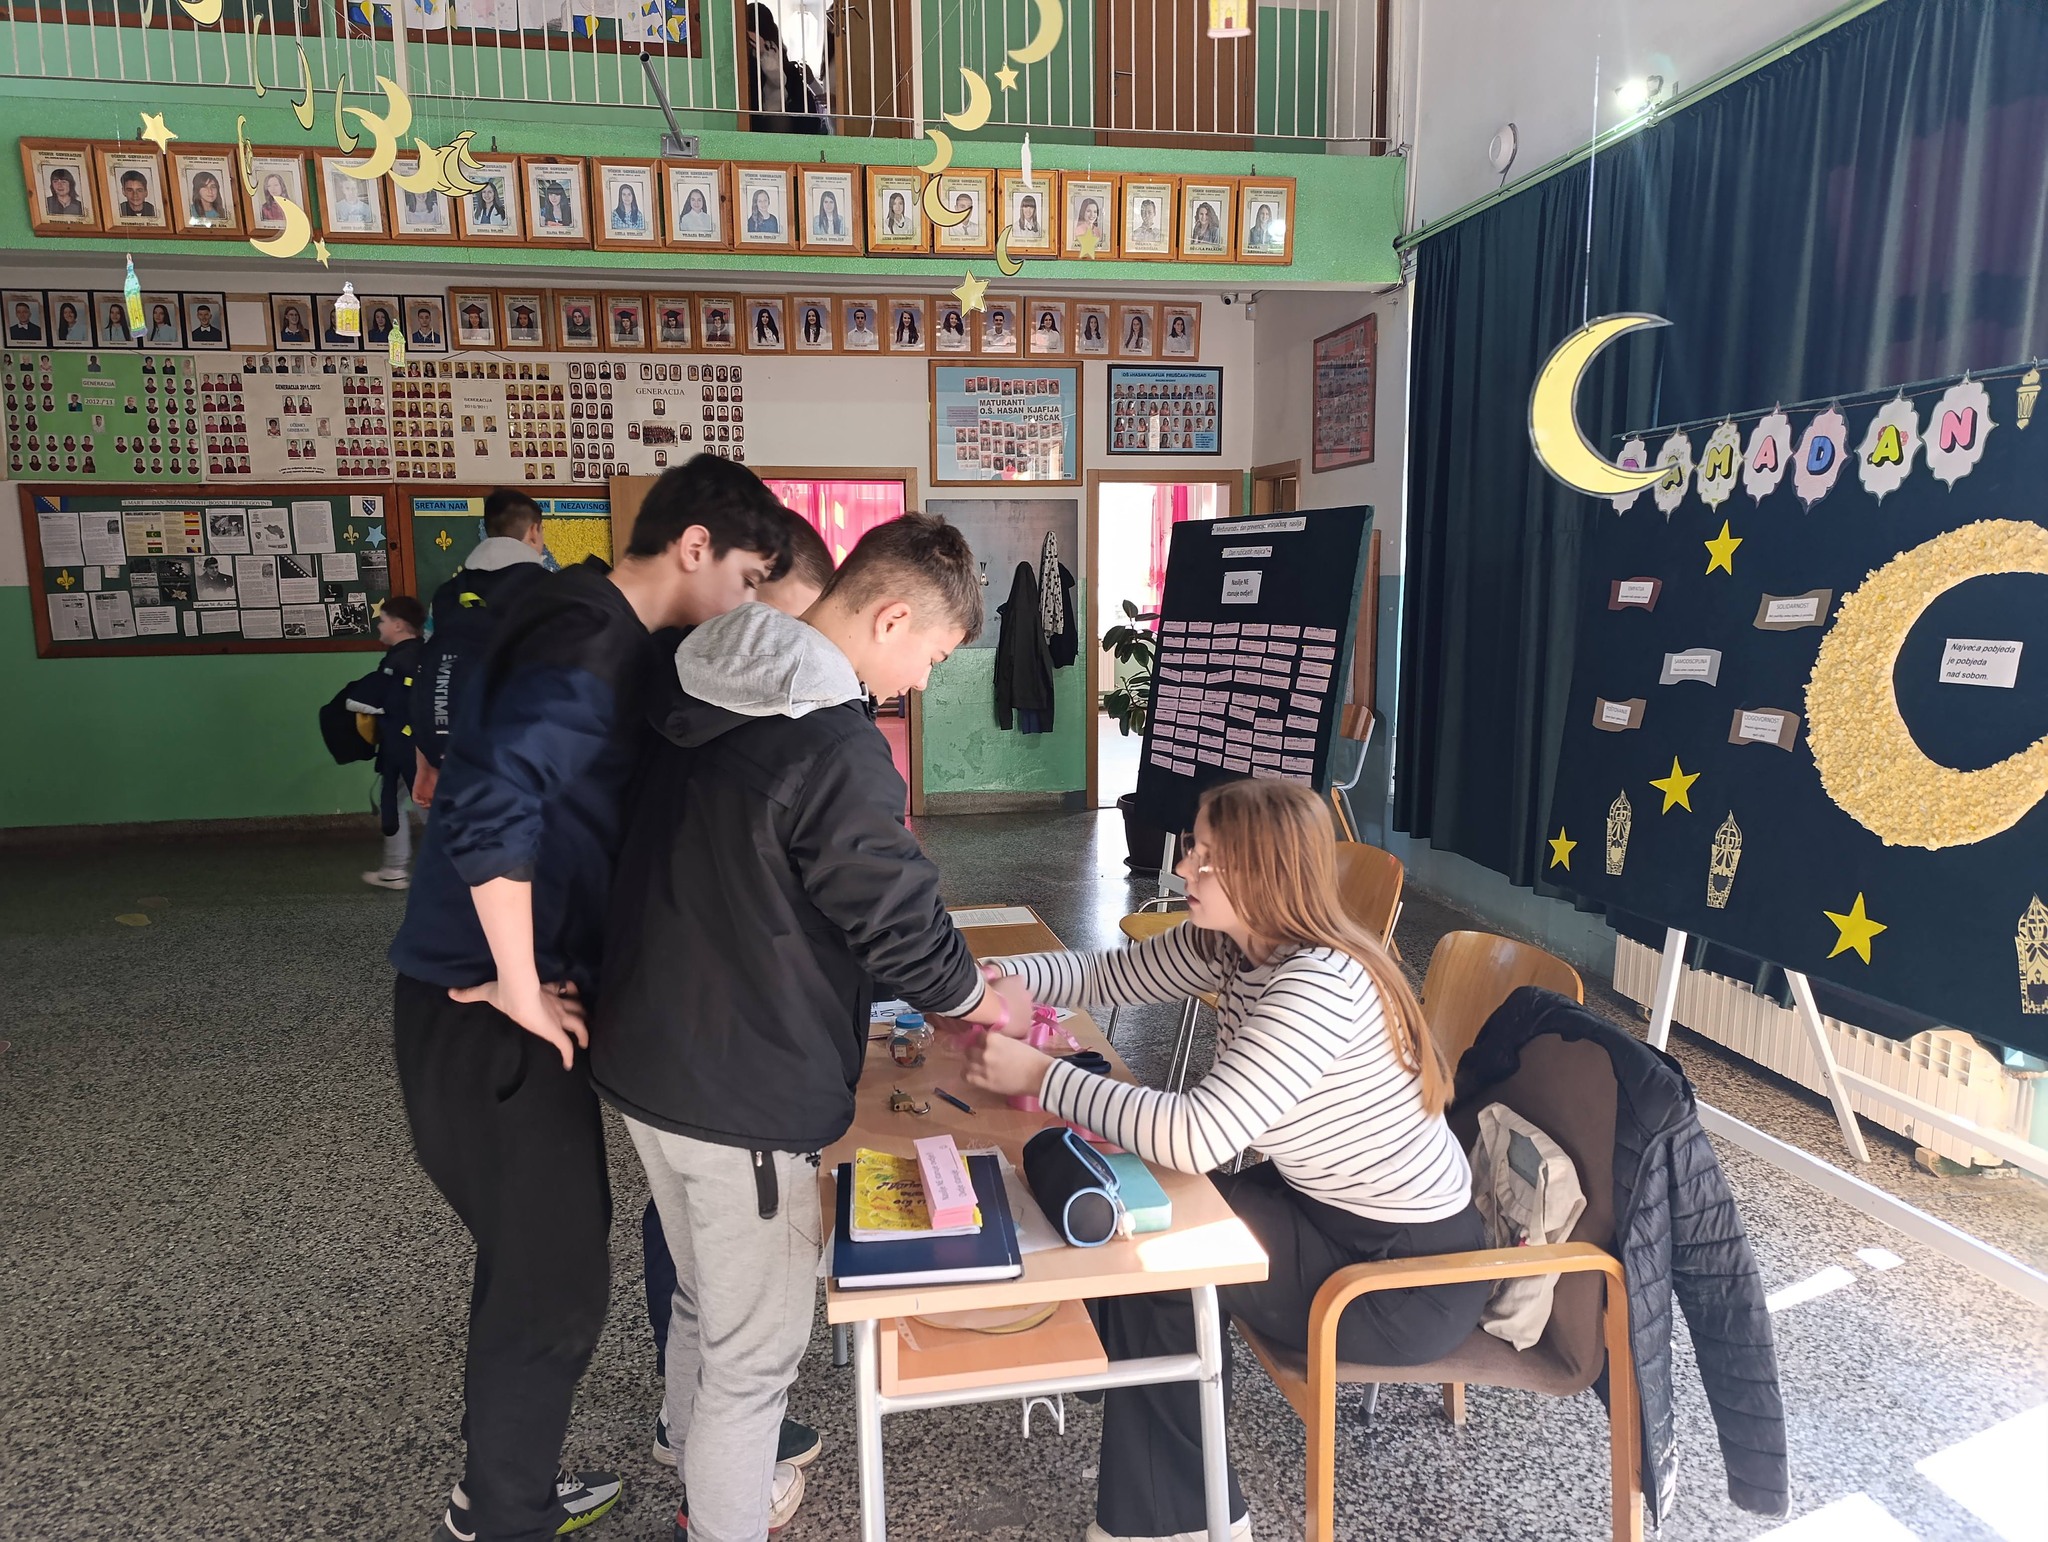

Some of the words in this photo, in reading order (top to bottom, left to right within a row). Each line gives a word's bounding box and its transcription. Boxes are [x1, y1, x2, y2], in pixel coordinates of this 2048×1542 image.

[635, 387, 685, 396] GENERACIJA
[979, 399, 1025, 407] MATURANTI
[979, 407, 995, 415] O.Š.
[1027, 406, 1060, 414] KJAFIJA
[1023, 413, 1060, 422] PRUŠČAK
[415, 502, 446, 510] SRETAN
[1981, 645, 2016, 654] pobjeda
[1946, 656, 1956, 665] je
[1956, 657, 1988, 667] pobjeda
[1946, 670, 1960, 678] nad
